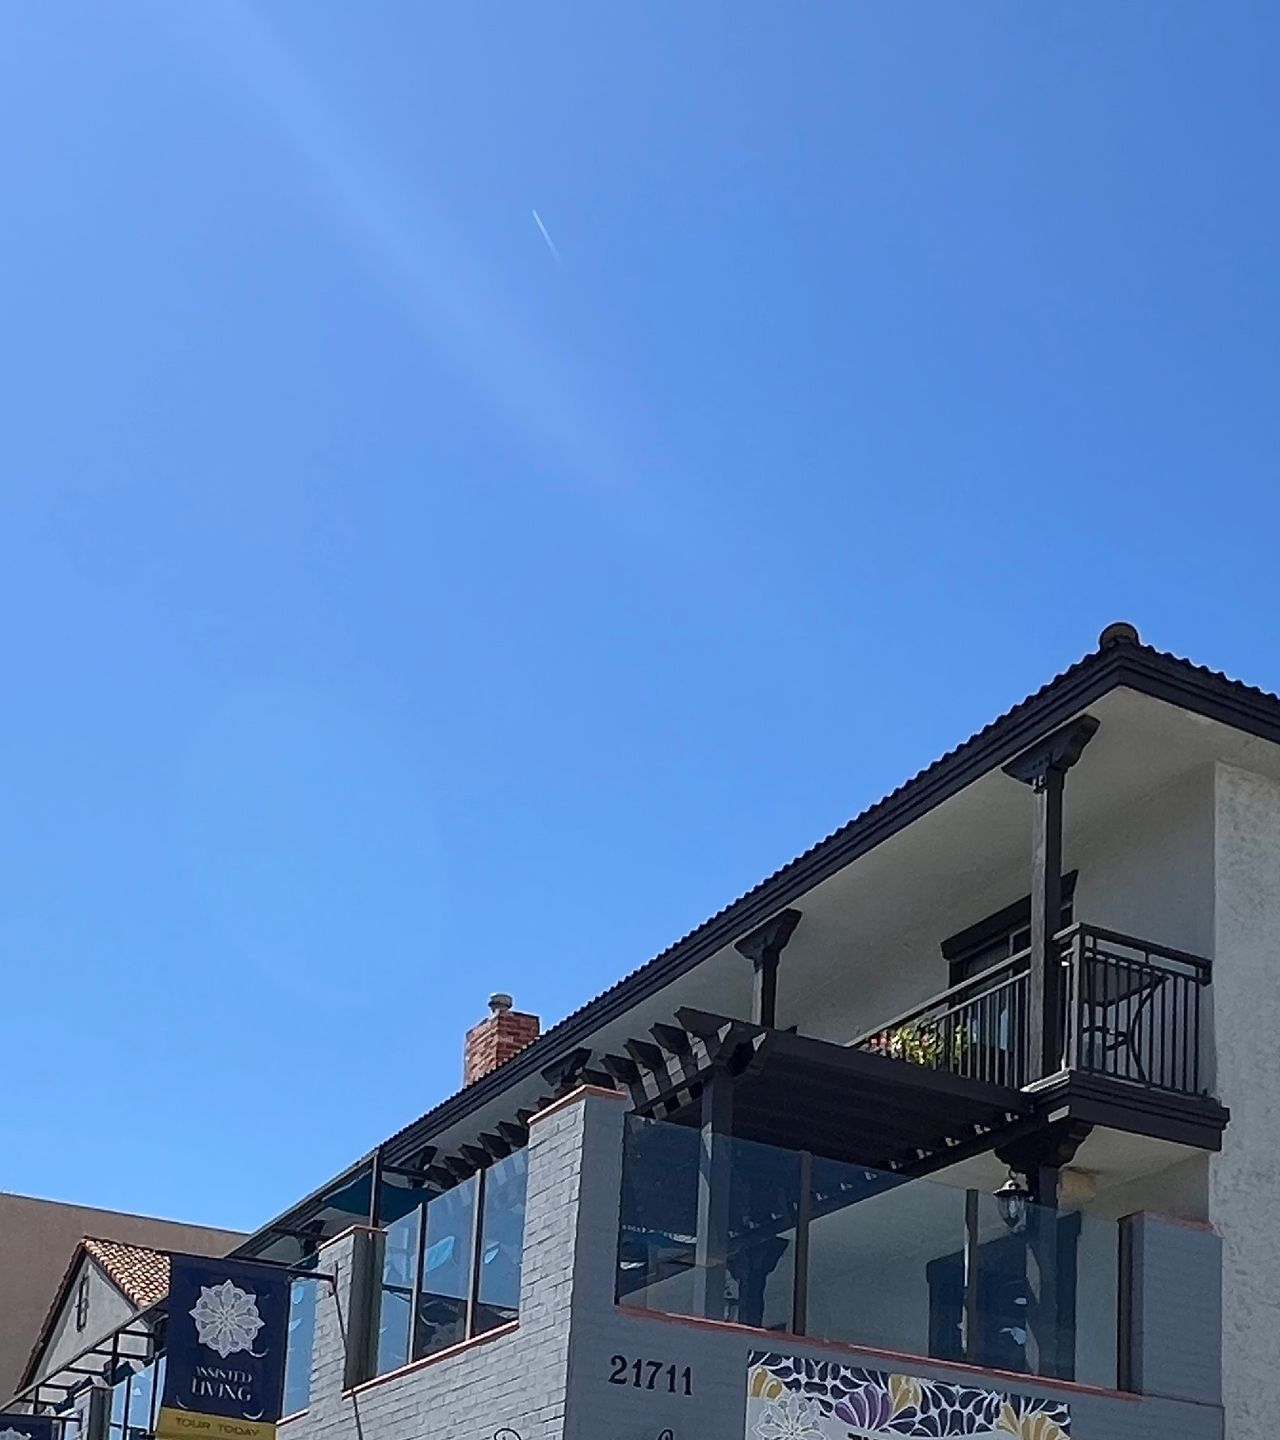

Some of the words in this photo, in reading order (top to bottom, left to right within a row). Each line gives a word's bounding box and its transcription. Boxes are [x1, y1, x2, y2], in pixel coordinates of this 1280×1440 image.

[607, 1354, 693, 1396] 21711
[191, 1378, 252, 1401] LIVING
[175, 1417, 211, 1430] TOUR
[217, 1424, 260, 1437] TODAY
